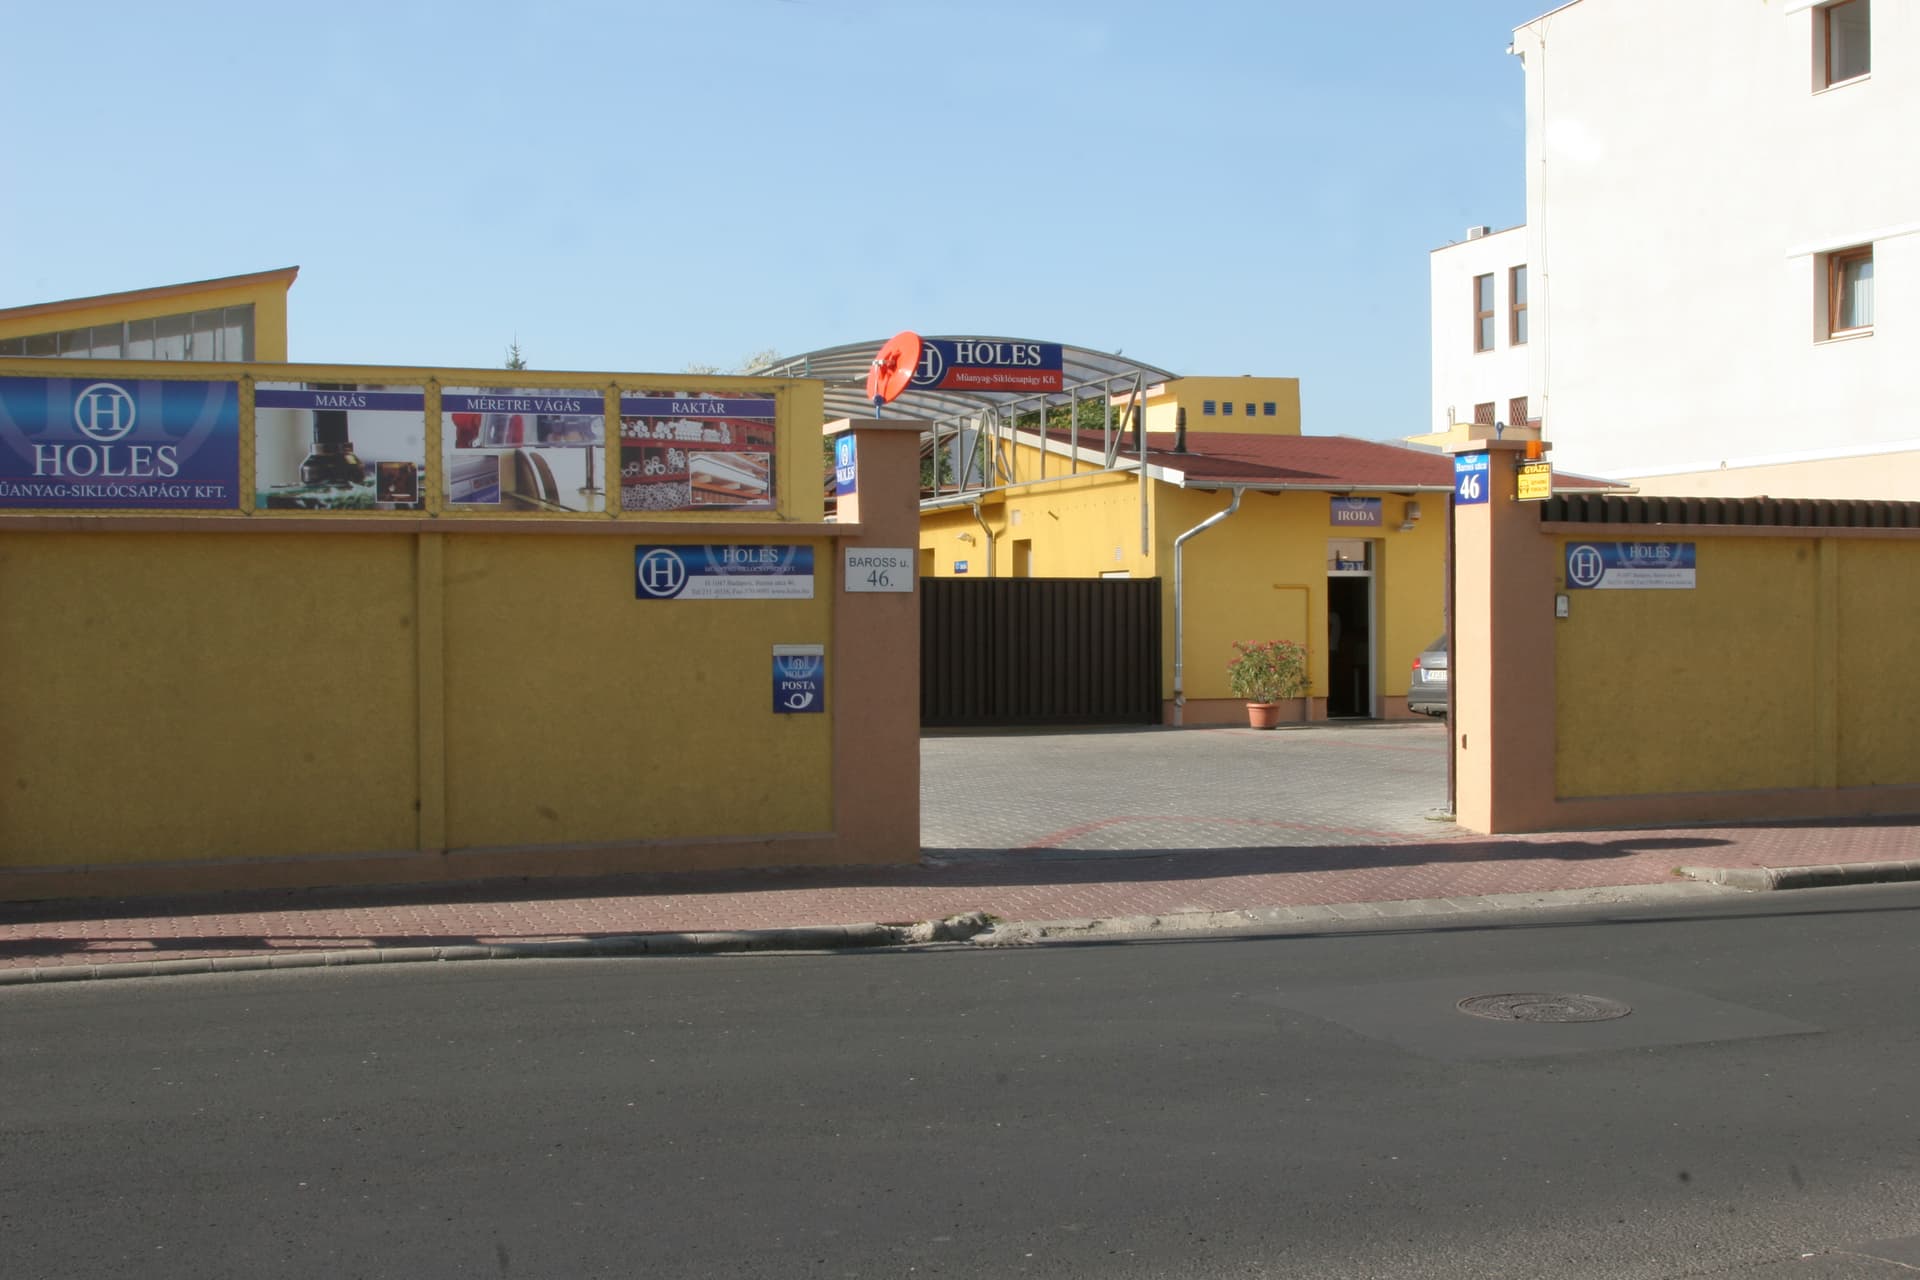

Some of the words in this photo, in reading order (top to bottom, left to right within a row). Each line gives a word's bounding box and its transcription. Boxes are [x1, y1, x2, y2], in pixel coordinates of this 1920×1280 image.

[954, 342, 1041, 366] HOLES
[314, 394, 367, 408] MARÁS
[467, 397, 532, 413] MÉRETRE
[535, 398, 581, 413] VÁGÁS
[672, 400, 726, 415] RAKTÁR
[32, 443, 180, 478] HOLES
[0, 481, 191, 498] ŰANYAG-SIKLÓCSAPÁGY
[195, 485, 227, 498] KFT.
[1459, 474, 1480, 499] 46
[1338, 511, 1375, 522] IRODA
[723, 548, 779, 564] HOLES
[1630, 546, 1671, 559] HOLES
[848, 557, 897, 569] BAROSS
[898, 558, 910, 569] u.
[866, 569, 895, 588] 46.
[781, 680, 816, 691] POSTA
